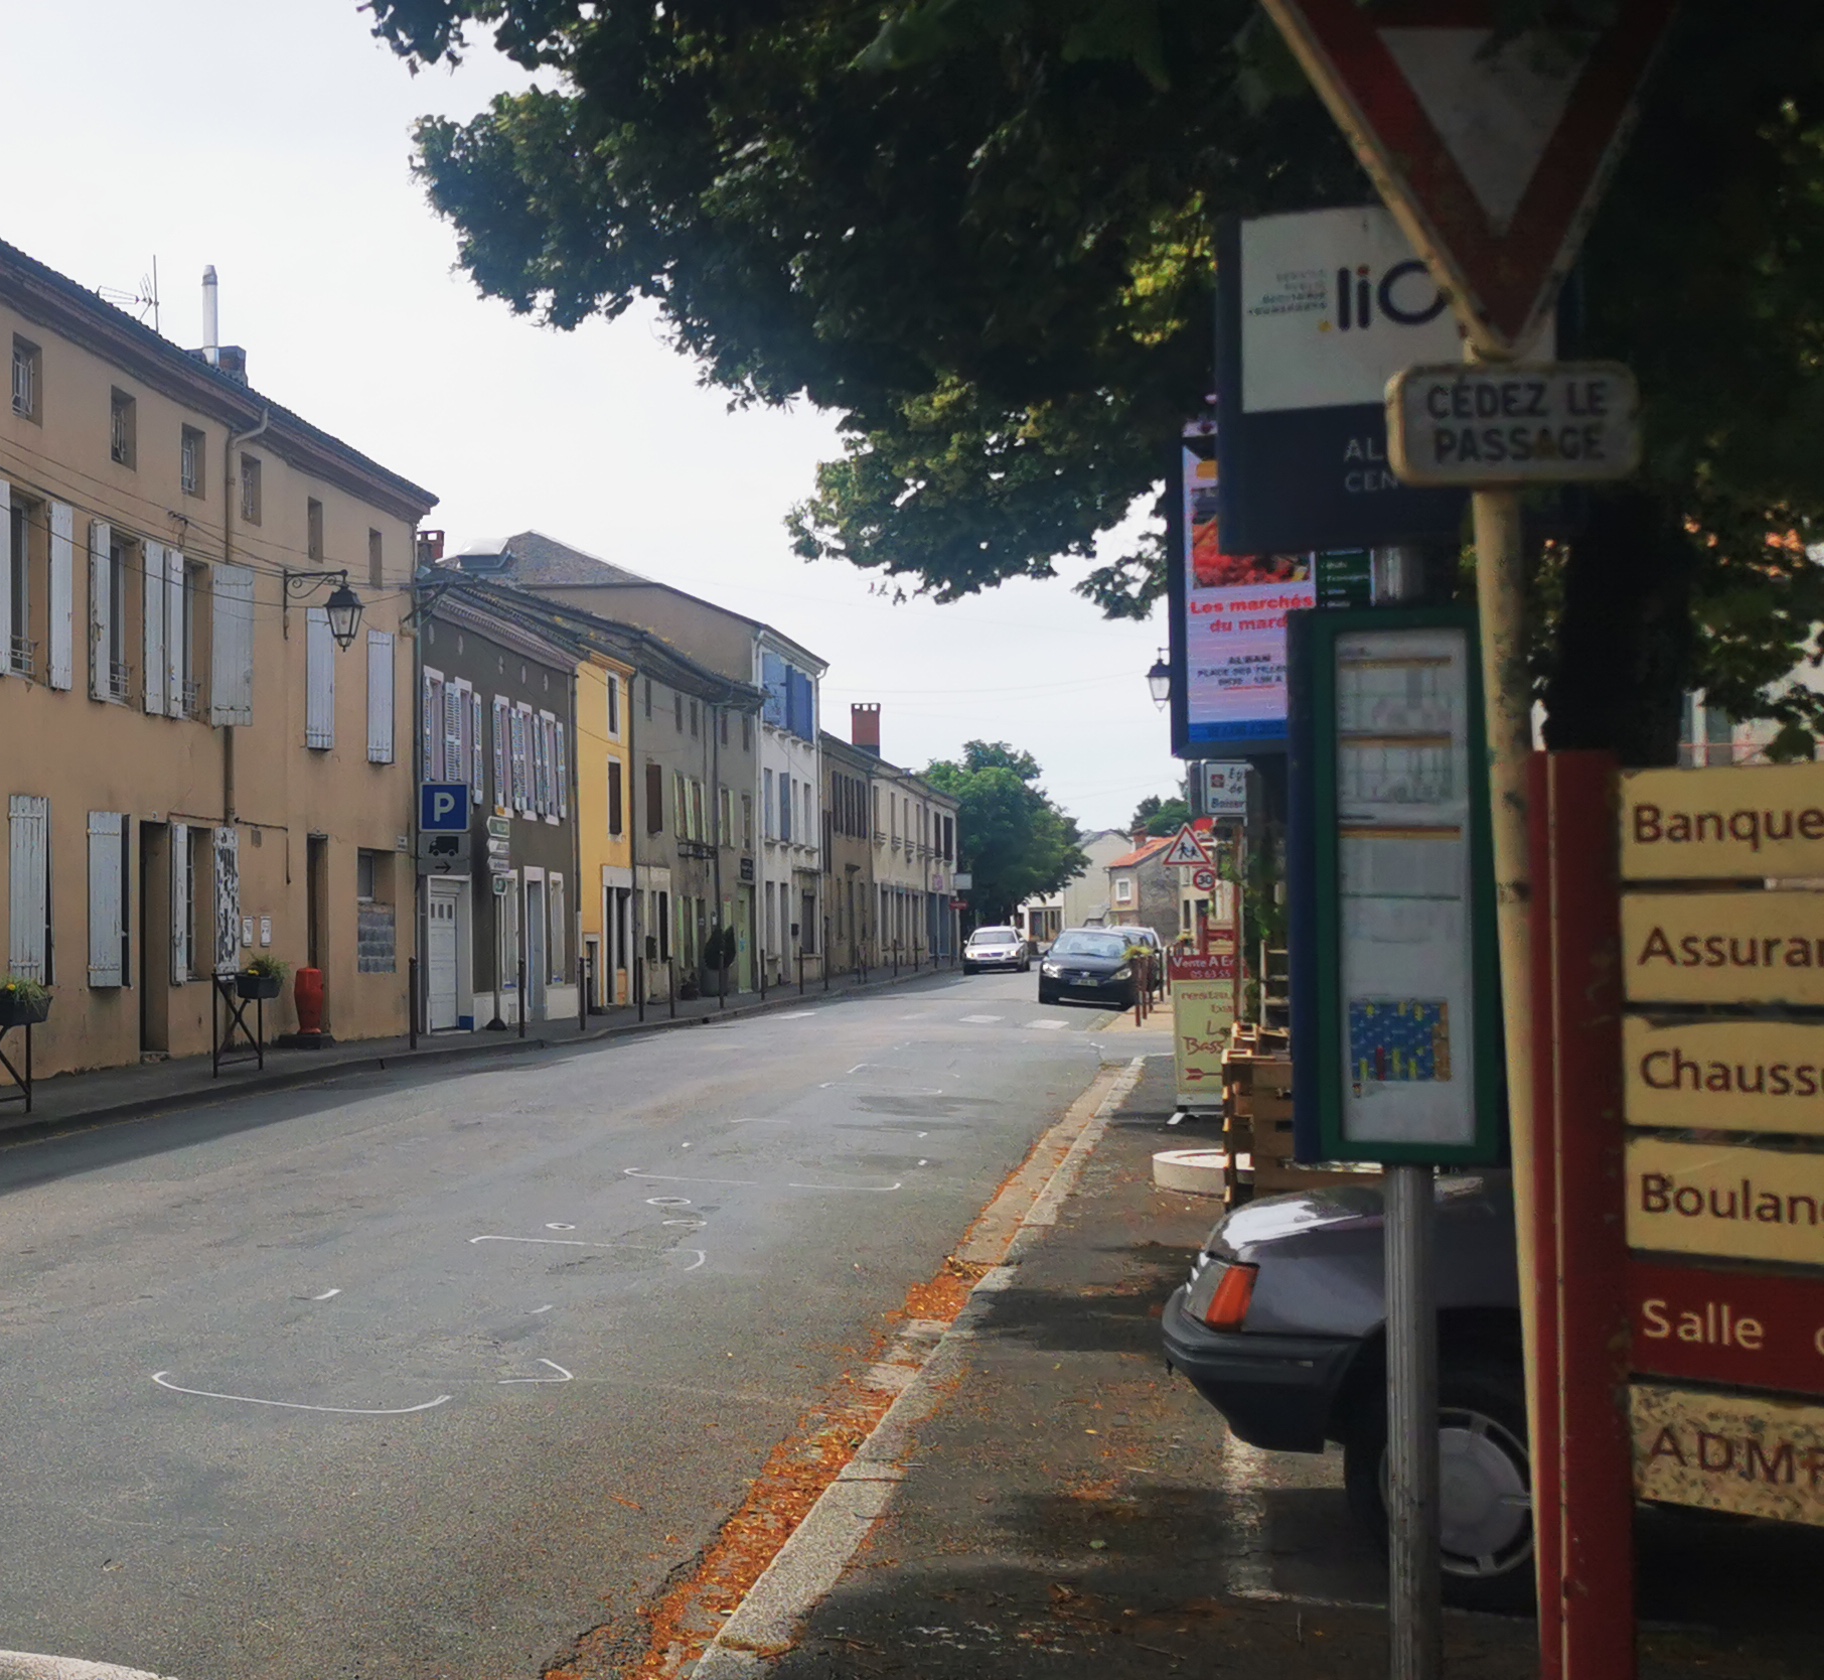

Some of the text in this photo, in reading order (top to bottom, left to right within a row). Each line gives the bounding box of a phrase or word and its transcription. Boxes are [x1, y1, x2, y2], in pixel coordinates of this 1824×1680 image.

[1427, 375, 1608, 420] CÉDEZ LE
[1433, 427, 1605, 463] PASSAGE
[1190, 594, 1313, 615] Les marchés
[1209, 615, 1288, 633] du mard
[434, 791, 456, 822] P
[1634, 804, 1824, 852] Banque
[1198, 874, 1212, 885] 30
[1172, 956, 1208, 968] Vente
[1182, 1035, 1225, 1055] Bass
[1640, 1047, 1824, 1097] Chauss
[1641, 1173, 1824, 1226] Boulan
[1642, 1298, 1765, 1350] Salle
